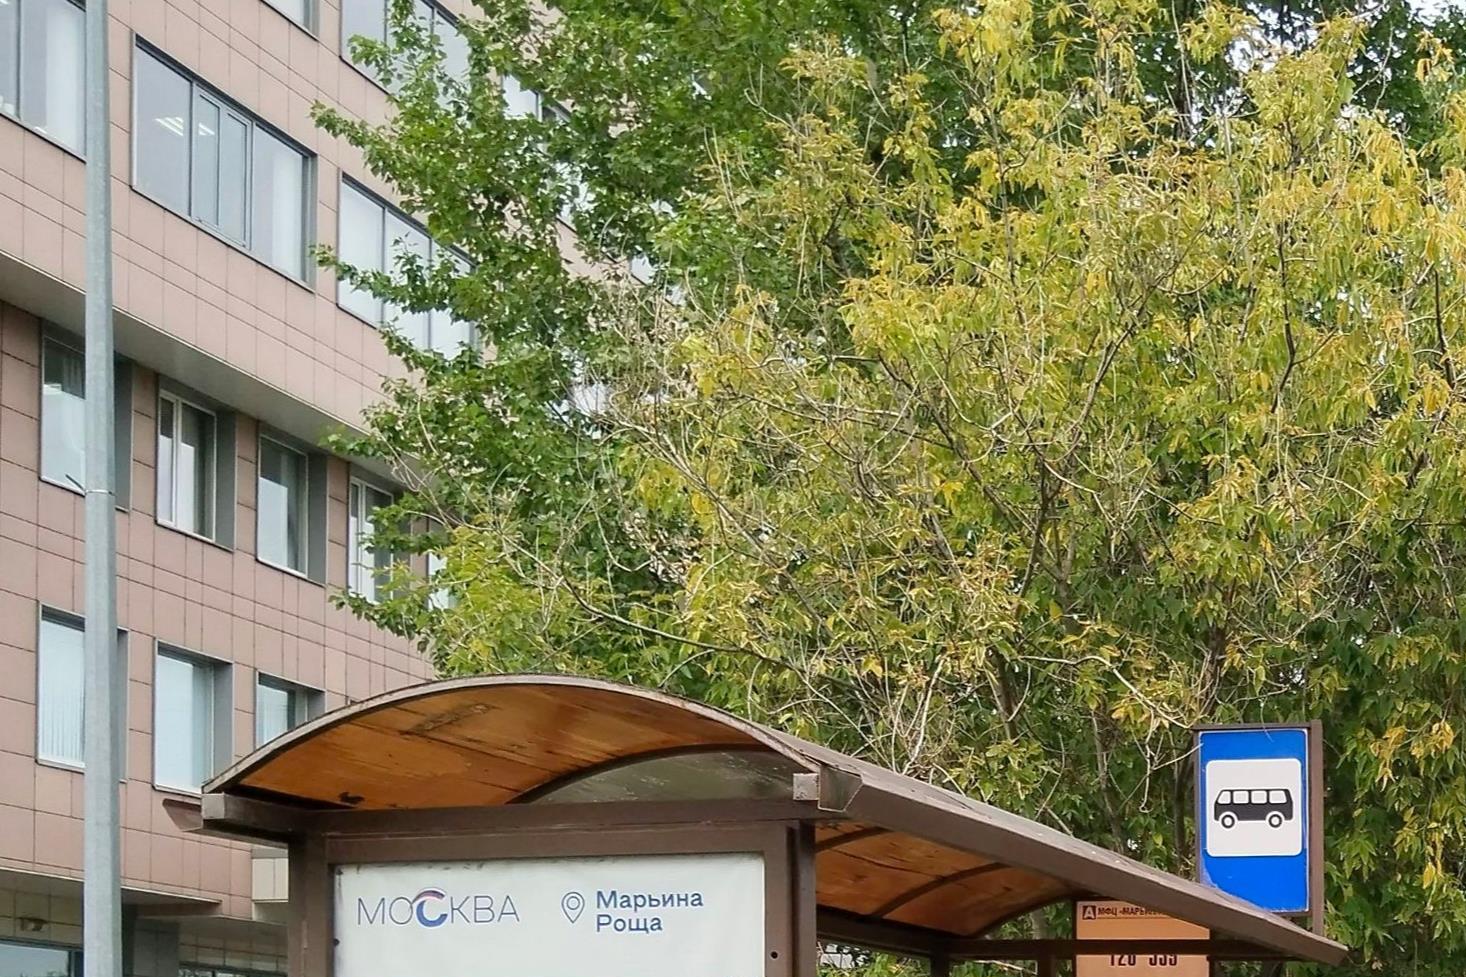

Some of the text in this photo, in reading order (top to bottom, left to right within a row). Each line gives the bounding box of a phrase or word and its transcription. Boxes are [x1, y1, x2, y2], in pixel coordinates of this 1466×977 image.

[356, 887, 521, 928] МОСКВА
[596, 890, 704, 914] Марьина
[596, 914, 663, 934] Роща
